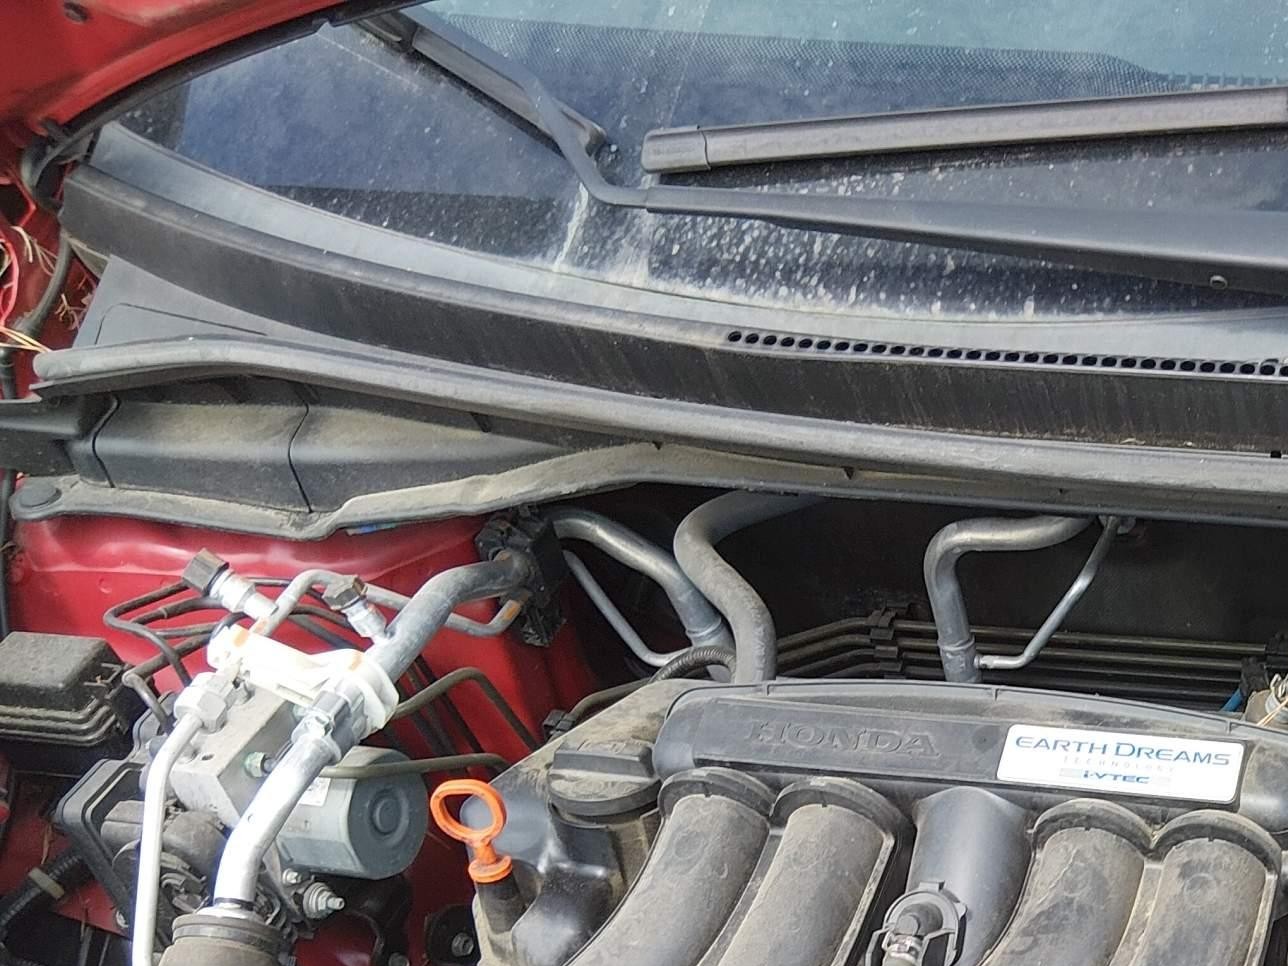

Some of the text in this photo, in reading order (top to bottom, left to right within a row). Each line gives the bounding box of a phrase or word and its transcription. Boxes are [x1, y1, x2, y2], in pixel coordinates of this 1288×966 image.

[746, 719, 941, 760] HONDA
[1015, 735, 1232, 766] EARTH DREAMS
[1063, 755, 1175, 772] TECHNOLOGY
[1083, 768, 1151, 784] i-VTEC
